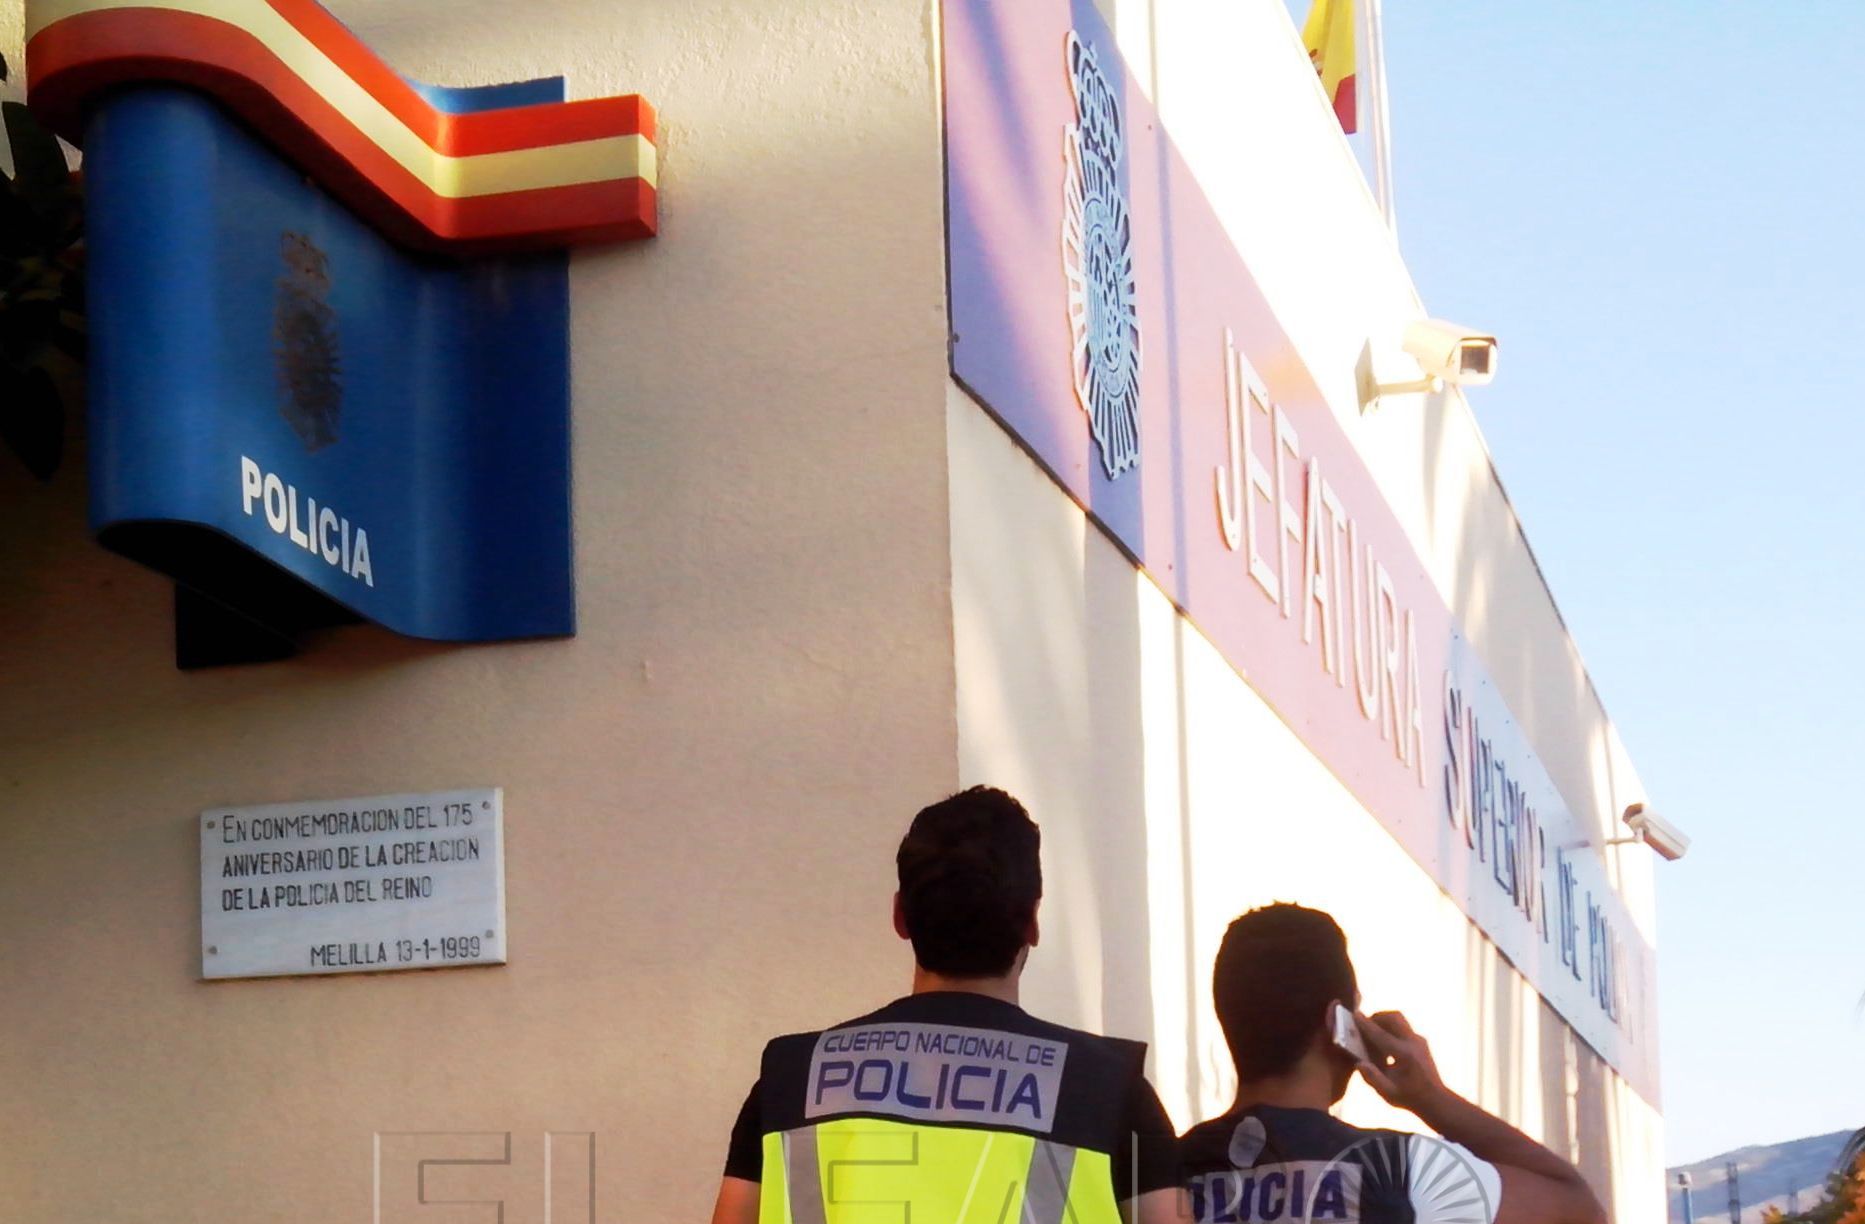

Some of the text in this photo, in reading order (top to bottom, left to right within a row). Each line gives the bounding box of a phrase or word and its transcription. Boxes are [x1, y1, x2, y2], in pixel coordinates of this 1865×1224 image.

[240, 455, 374, 588] POLICIA
[1214, 325, 1428, 787] JEFATURA
[222, 803, 473, 844] EN CONMEMORACION DEL 175
[222, 837, 480, 878] ANIVERSARIO DE LA CREACION
[221, 875, 433, 912] DE LA POLICIA DEL REINO
[310, 935, 481, 967] MELILLA 13-1-1999
[823, 1030, 1057, 1067] CUERPO NACIONAL DE
[815, 1058, 1042, 1120] POLICIA
